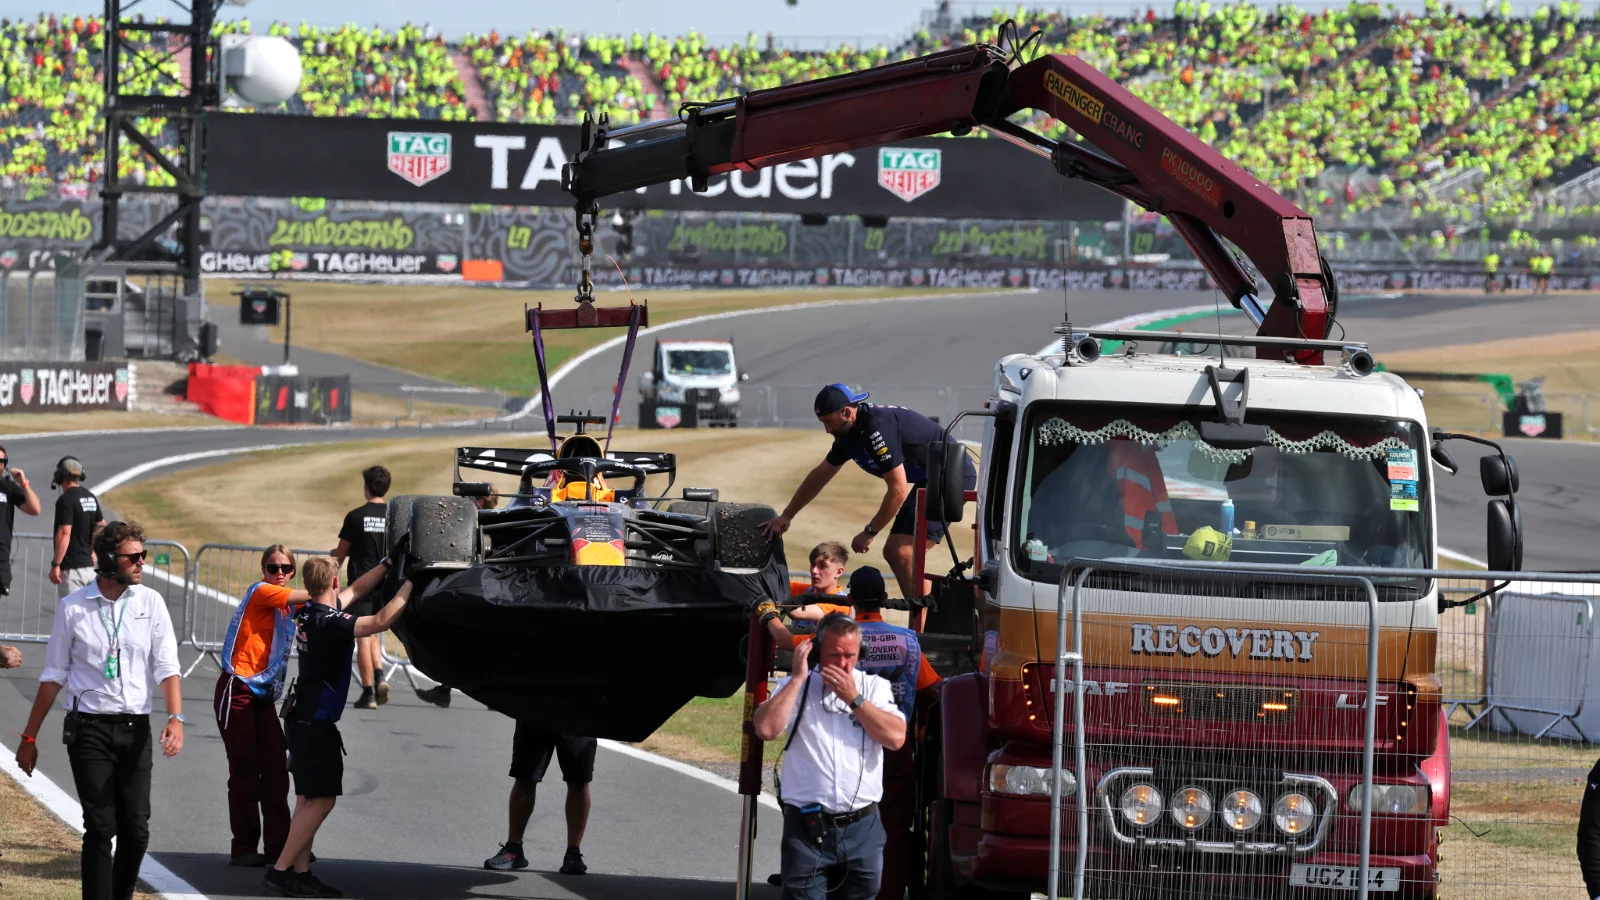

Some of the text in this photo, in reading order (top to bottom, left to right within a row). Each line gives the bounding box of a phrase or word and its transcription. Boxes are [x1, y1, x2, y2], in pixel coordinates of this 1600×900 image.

[1047, 73, 1101, 121] PALFINGER
[393, 135, 446, 154] TAG
[390, 156, 450, 181] HEUER
[886, 151, 934, 169] TAG
[881, 171, 940, 195] HEUER
[313, 253, 427, 272] TAGHeuer
[37, 368, 113, 406] TAGHeuer
[869, 645, 898, 654] COVERY
[1130, 623, 1320, 663] RECOVERY
[1305, 866, 1345, 886] UGZ
